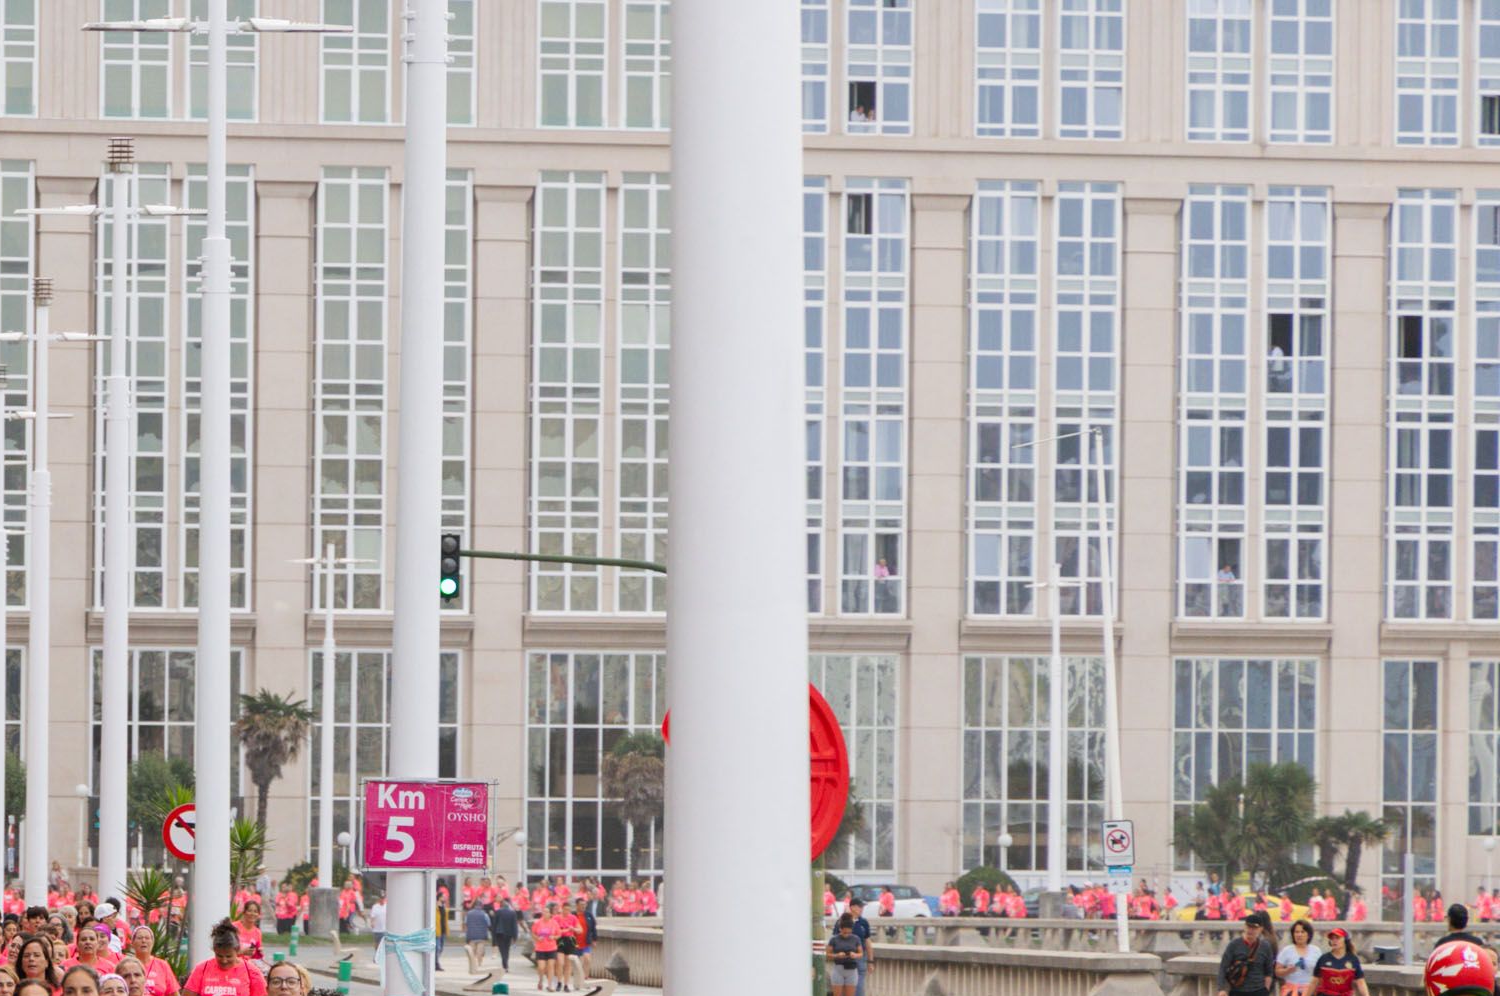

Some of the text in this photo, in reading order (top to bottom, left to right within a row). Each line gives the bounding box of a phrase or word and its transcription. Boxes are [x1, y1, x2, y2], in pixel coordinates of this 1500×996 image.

[378, 783, 425, 810] Km
[447, 812, 486, 823] OYSHO
[383, 815, 415, 862] 5
[452, 843, 484, 851] DISFRUTA
[454, 857, 484, 865] DEPORTE
